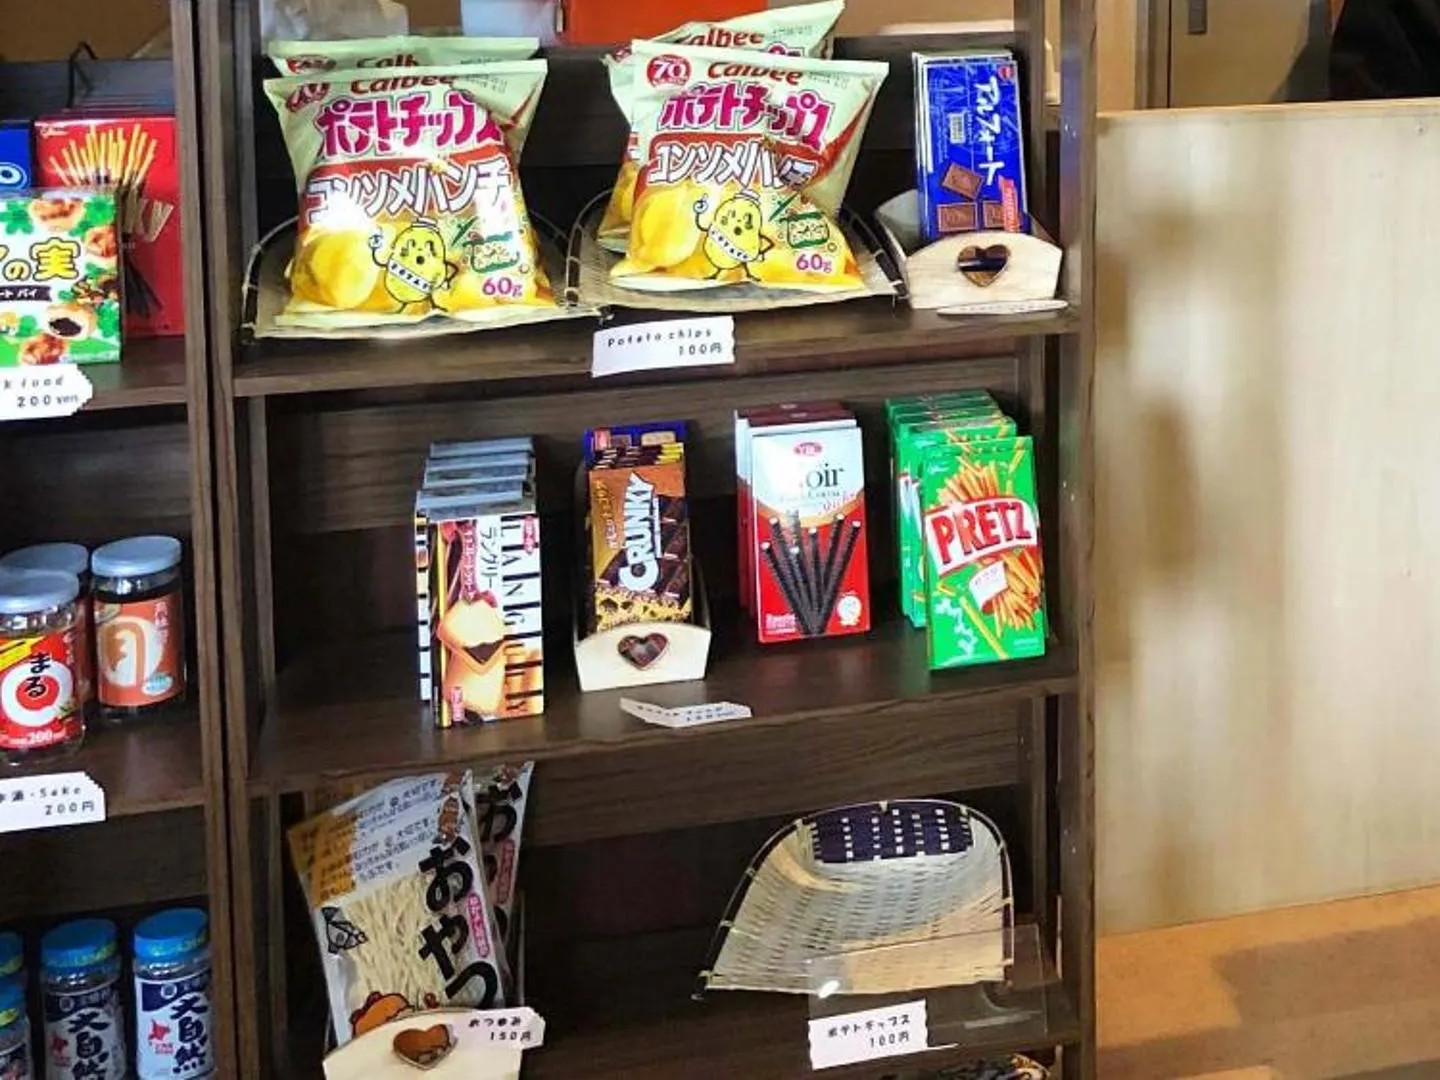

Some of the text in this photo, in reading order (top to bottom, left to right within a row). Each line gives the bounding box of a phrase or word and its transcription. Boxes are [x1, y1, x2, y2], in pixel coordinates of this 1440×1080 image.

[350, 74, 460, 95] Calbee
[707, 61, 804, 86] Calbee
[0, 236, 81, 282] の実
[796, 252, 833, 274] 60g
[481, 275, 523, 298] 60g
[608, 328, 713, 348] Potato chips
[678, 341, 722, 357] 100円
[799, 463, 846, 489] oir
[619, 471, 659, 592] CRUNKY
[930, 501, 1031, 566] PRETZ
[480, 526, 498, 589] ラングリー
[26, 651, 51, 698] まる
[45, 800, 95, 816] 200円
[417, 836, 498, 1011] おやつ
[169, 994, 209, 1075] 大自然
[468, 1017, 521, 1028] おつまみ
[827, 1014, 910, 1038] ポテトチップス
[489, 1030, 532, 1042] 150円
[870, 1031, 910, 1048] 100円
